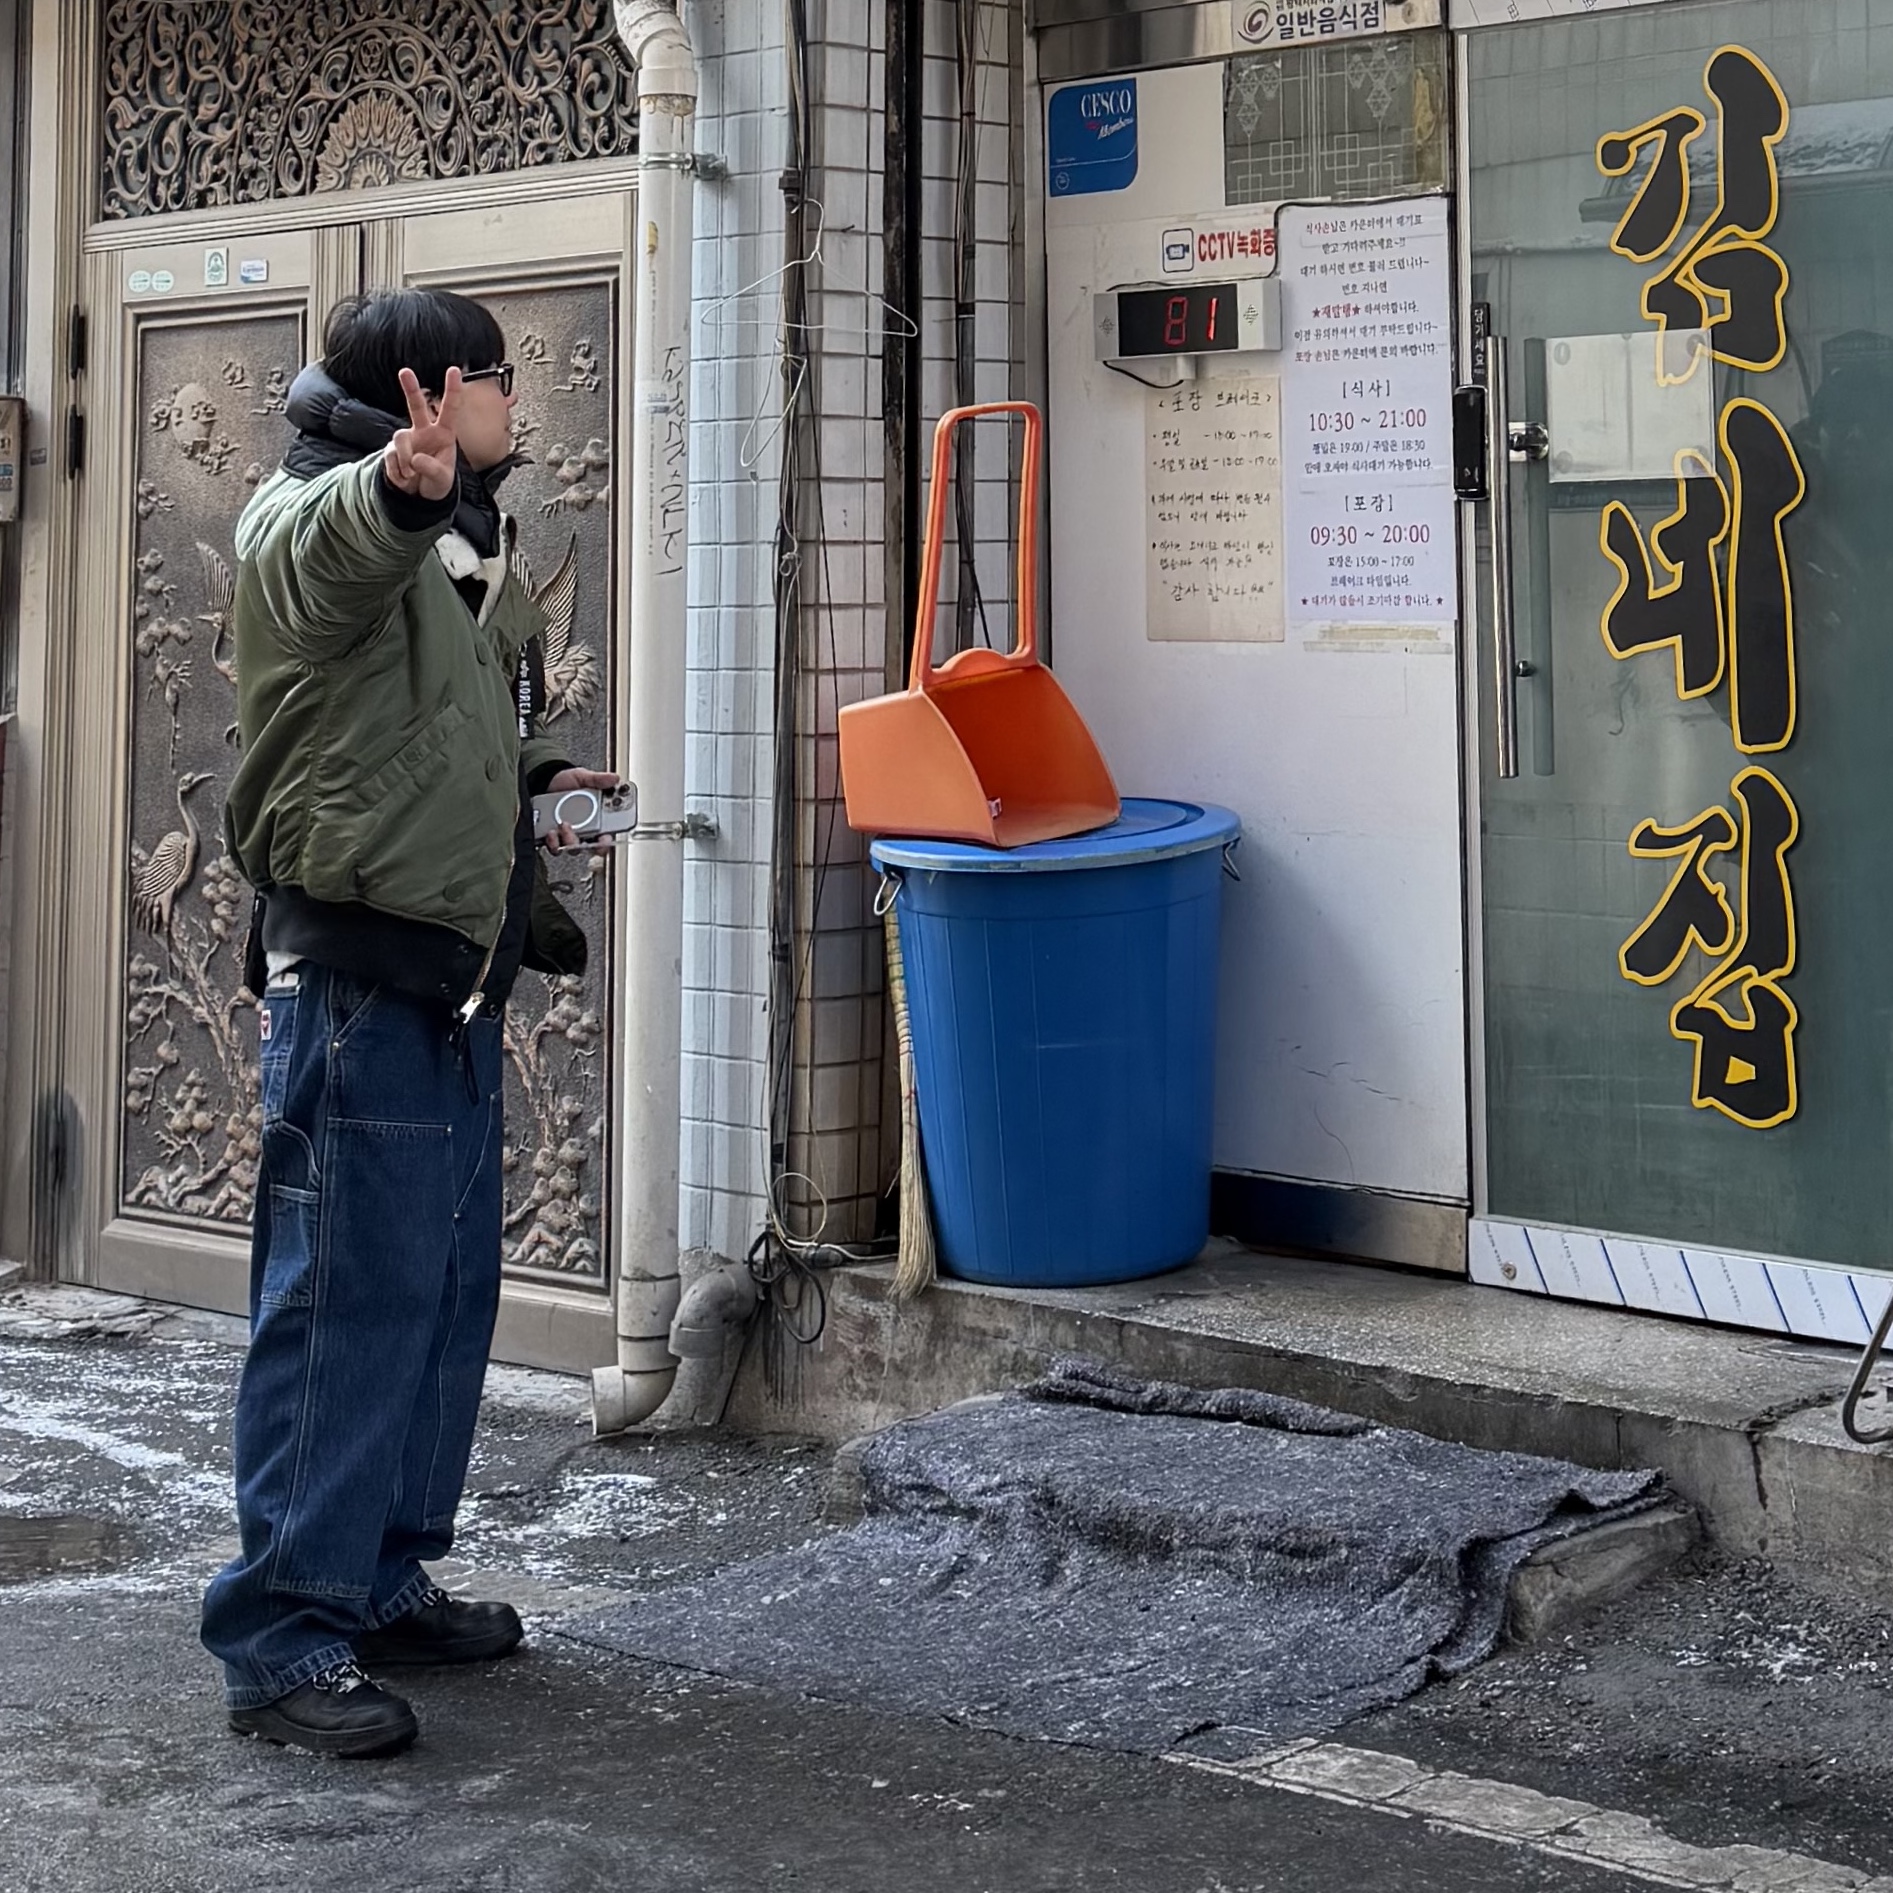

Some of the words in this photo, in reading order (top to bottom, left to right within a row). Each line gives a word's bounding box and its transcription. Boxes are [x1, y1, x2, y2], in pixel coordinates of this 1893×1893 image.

[1276, 1, 1379, 40] 일반음식점
[1081, 88, 1131, 118] CESCO
[1164, 296, 1219, 347] 81
[1474, 309, 1485, 367] 당기세요
[1310, 411, 1354, 432] 10:30
[1379, 408, 1427, 429] 21:00
[1401, 439, 1426, 452] 18:30
[1310, 525, 1357, 546] 09:30
[1382, 523, 1430, 543] 20:00
